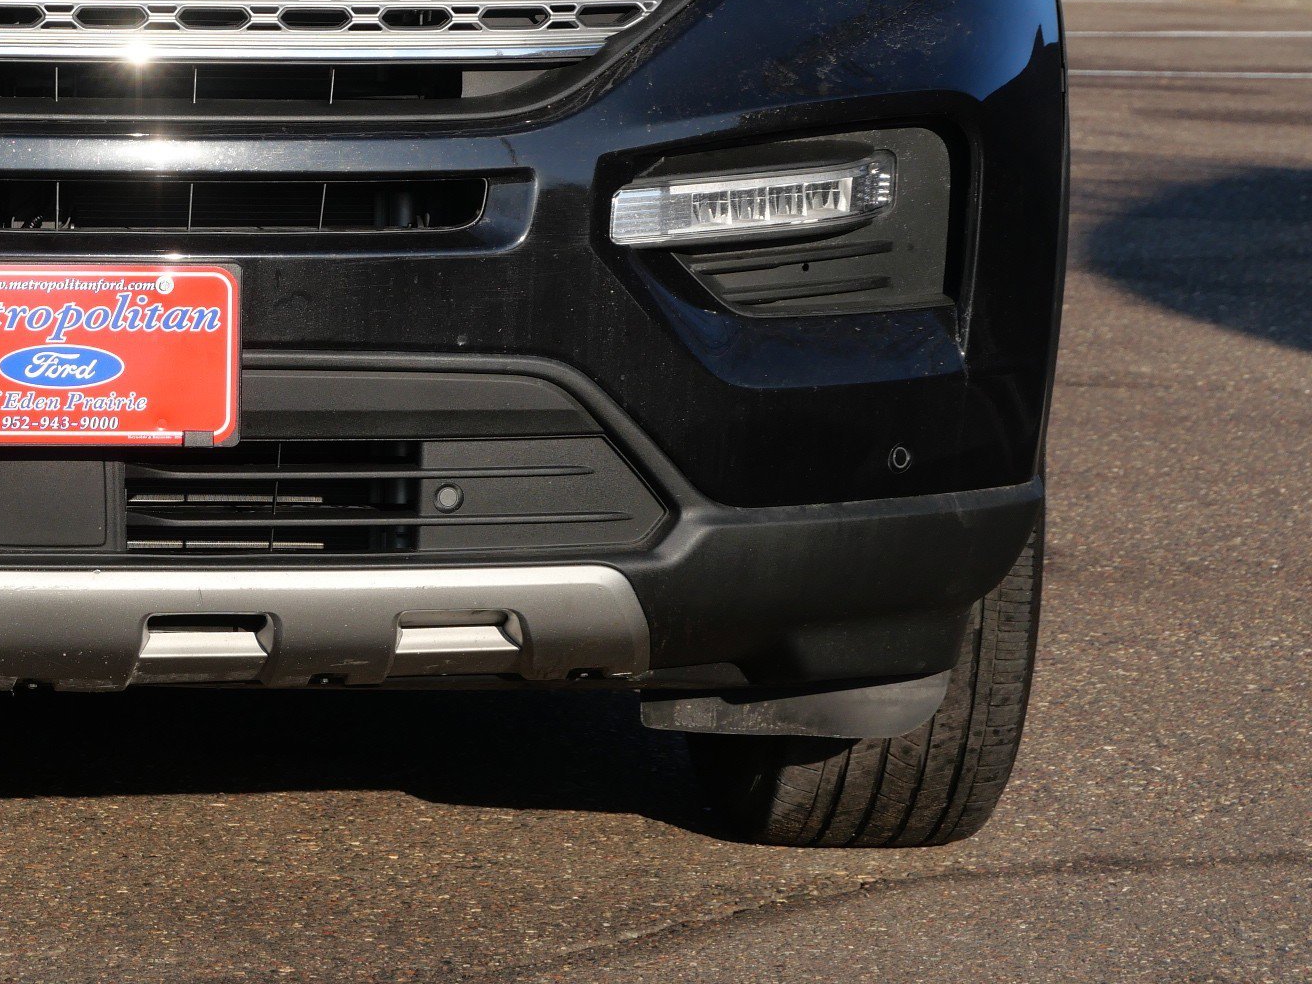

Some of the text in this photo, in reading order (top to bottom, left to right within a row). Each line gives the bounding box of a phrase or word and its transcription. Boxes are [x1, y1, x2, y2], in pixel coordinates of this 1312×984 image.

[24, 351, 98, 380] Ford
[1, 390, 61, 411] Eden
[64, 390, 148, 411] Prairie
[1, 415, 119, 430] 952-943-9000
